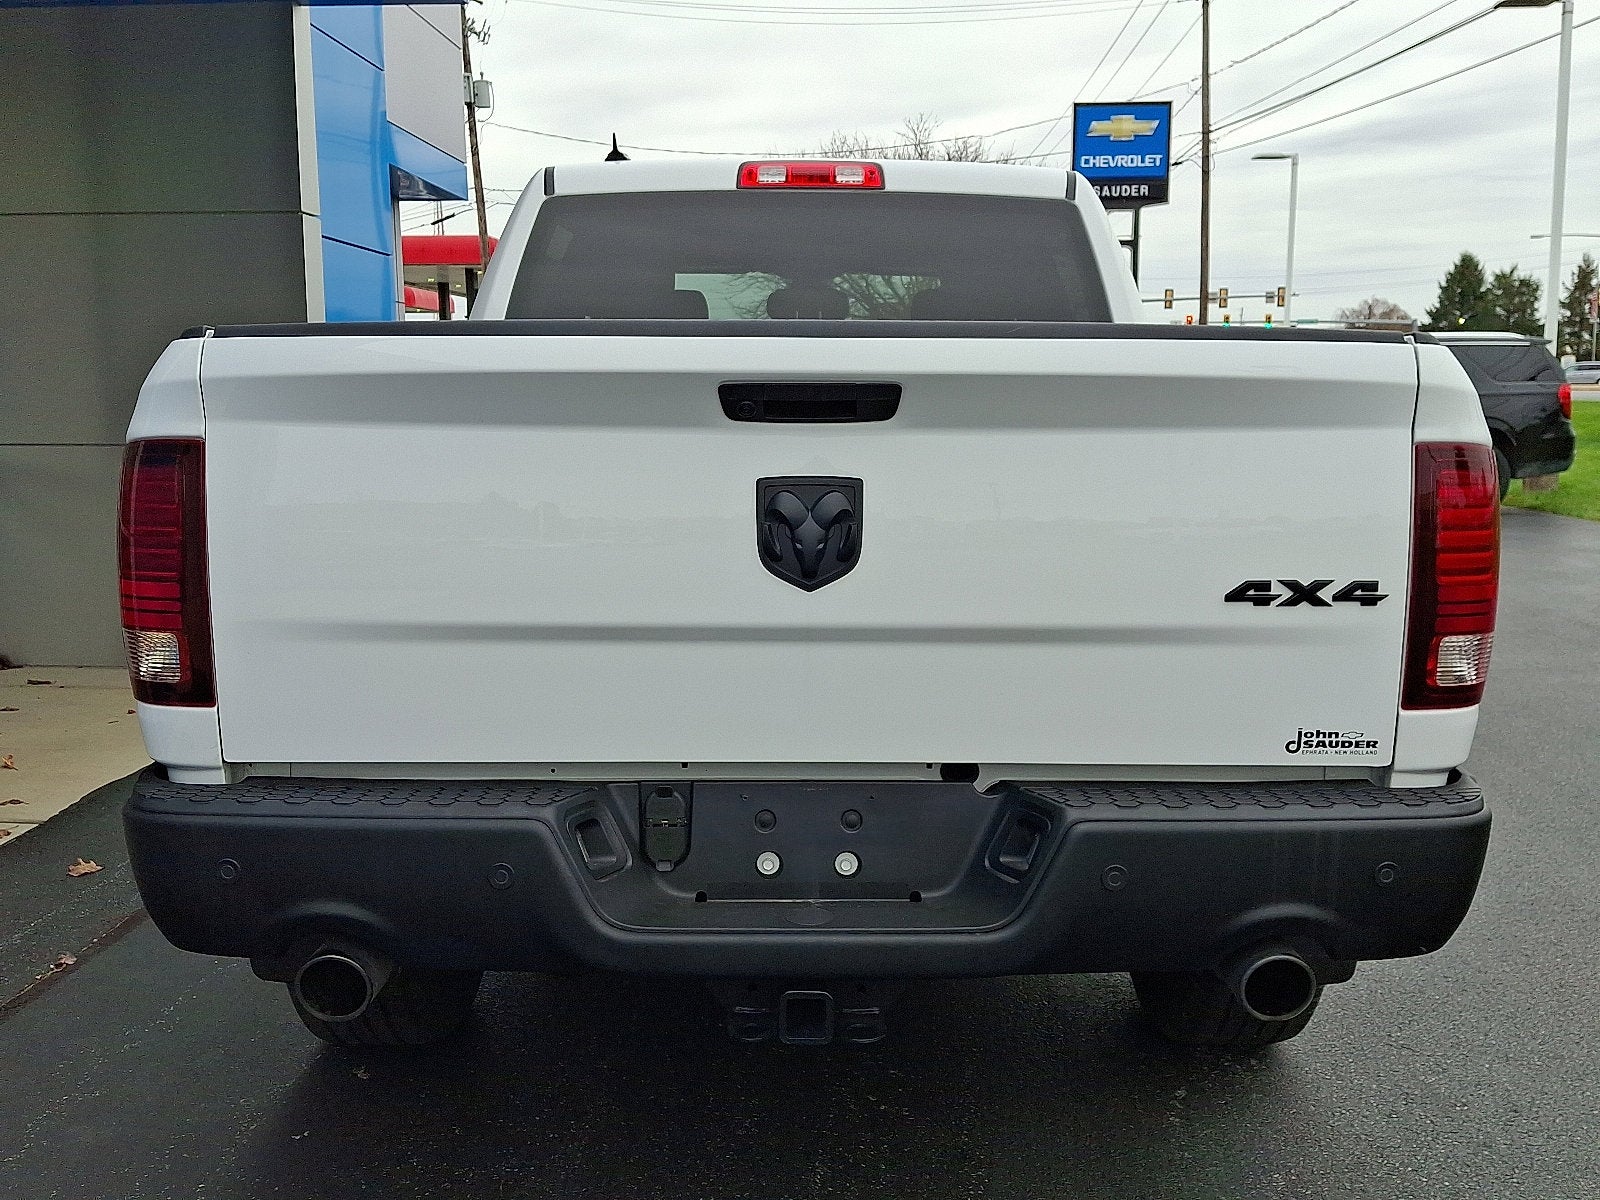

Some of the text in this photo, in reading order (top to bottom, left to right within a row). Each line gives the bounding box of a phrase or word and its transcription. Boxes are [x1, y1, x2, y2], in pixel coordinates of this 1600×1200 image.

[1081, 154, 1163, 168] CHEVROLET
[1093, 184, 1149, 197] SAUDER
[1224, 579, 1390, 607] 4X4
[1285, 727, 1339, 754] john
[1302, 739, 1379, 749] SAUDER
